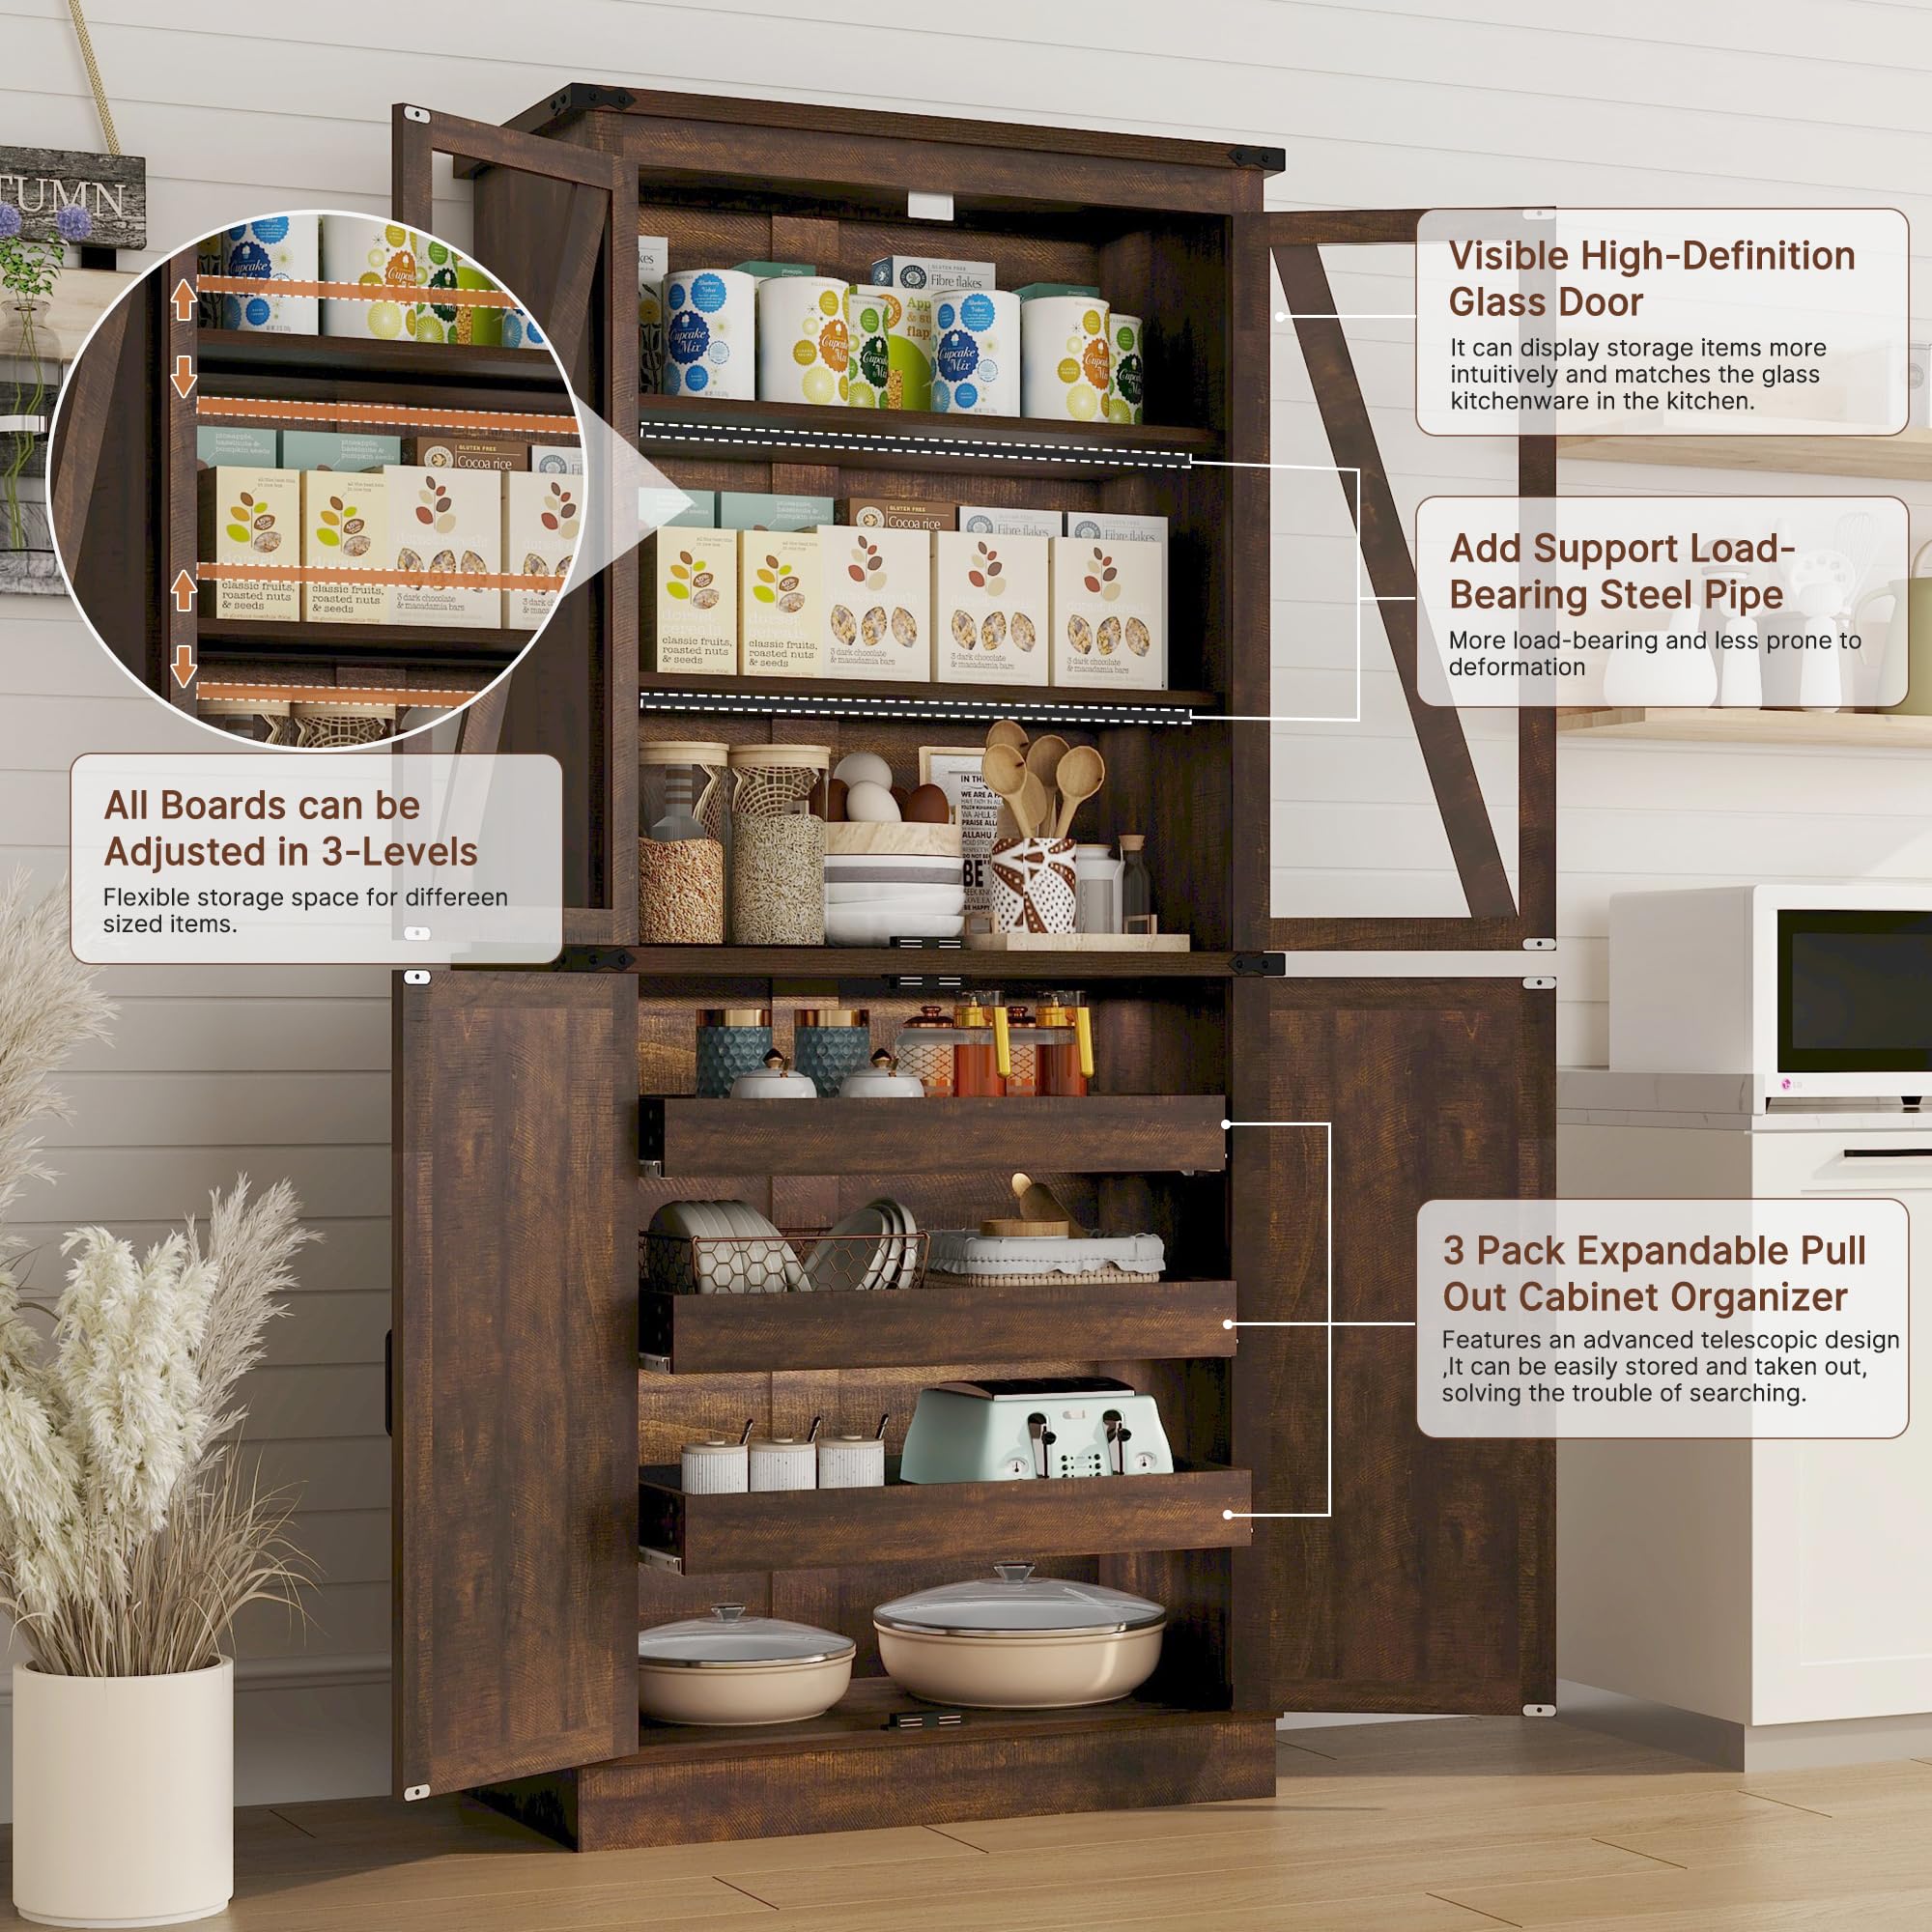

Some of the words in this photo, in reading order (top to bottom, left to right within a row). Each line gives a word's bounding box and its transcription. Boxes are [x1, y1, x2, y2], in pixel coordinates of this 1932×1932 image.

[931, 273, 954, 287] Fibre
[956, 274, 982, 289] flakes
[907, 312, 917, 323] &
[670, 328, 706, 344] Cupcake
[681, 340, 702, 354] Mix
[939, 347, 976, 362] Cupcake
[951, 358, 972, 372] Mix
[458, 455, 491, 469] Cocoa
[494, 457, 512, 470] rice
[889, 515, 920, 529] Cocoa
[923, 517, 941, 530] rice
[221, 582, 259, 590] classic
[262, 582, 295, 592] fruits,
[312, 584, 349, 593] classic
[351, 585, 384, 596] fruits,
[222, 591, 263, 601] roasted
[266, 592, 292, 601] nuts
[312, 594, 353, 604] roasted
[355, 596, 381, 605] nuts
[234, 601, 265, 611] seeds
[312, 604, 323, 612] &
[324, 604, 354, 613] seeds
[662, 636, 698, 645] classic
[700, 637, 732, 647] fruits,
[749, 639, 783, 648] classic
[786, 640, 818, 651] fruits,
[662, 645, 701, 655] roasted
[704, 647, 729, 656] nuts
[749, 649, 787, 659] roasted
[790, 650, 814, 659] nuts
[673, 655, 703, 665] seeds
[749, 658, 758, 667] &
[760, 658, 789, 668] seeds
[961, 775, 970, 783] IN
[962, 831, 992, 839] ALLAHU
[963, 859, 984, 888] BE
